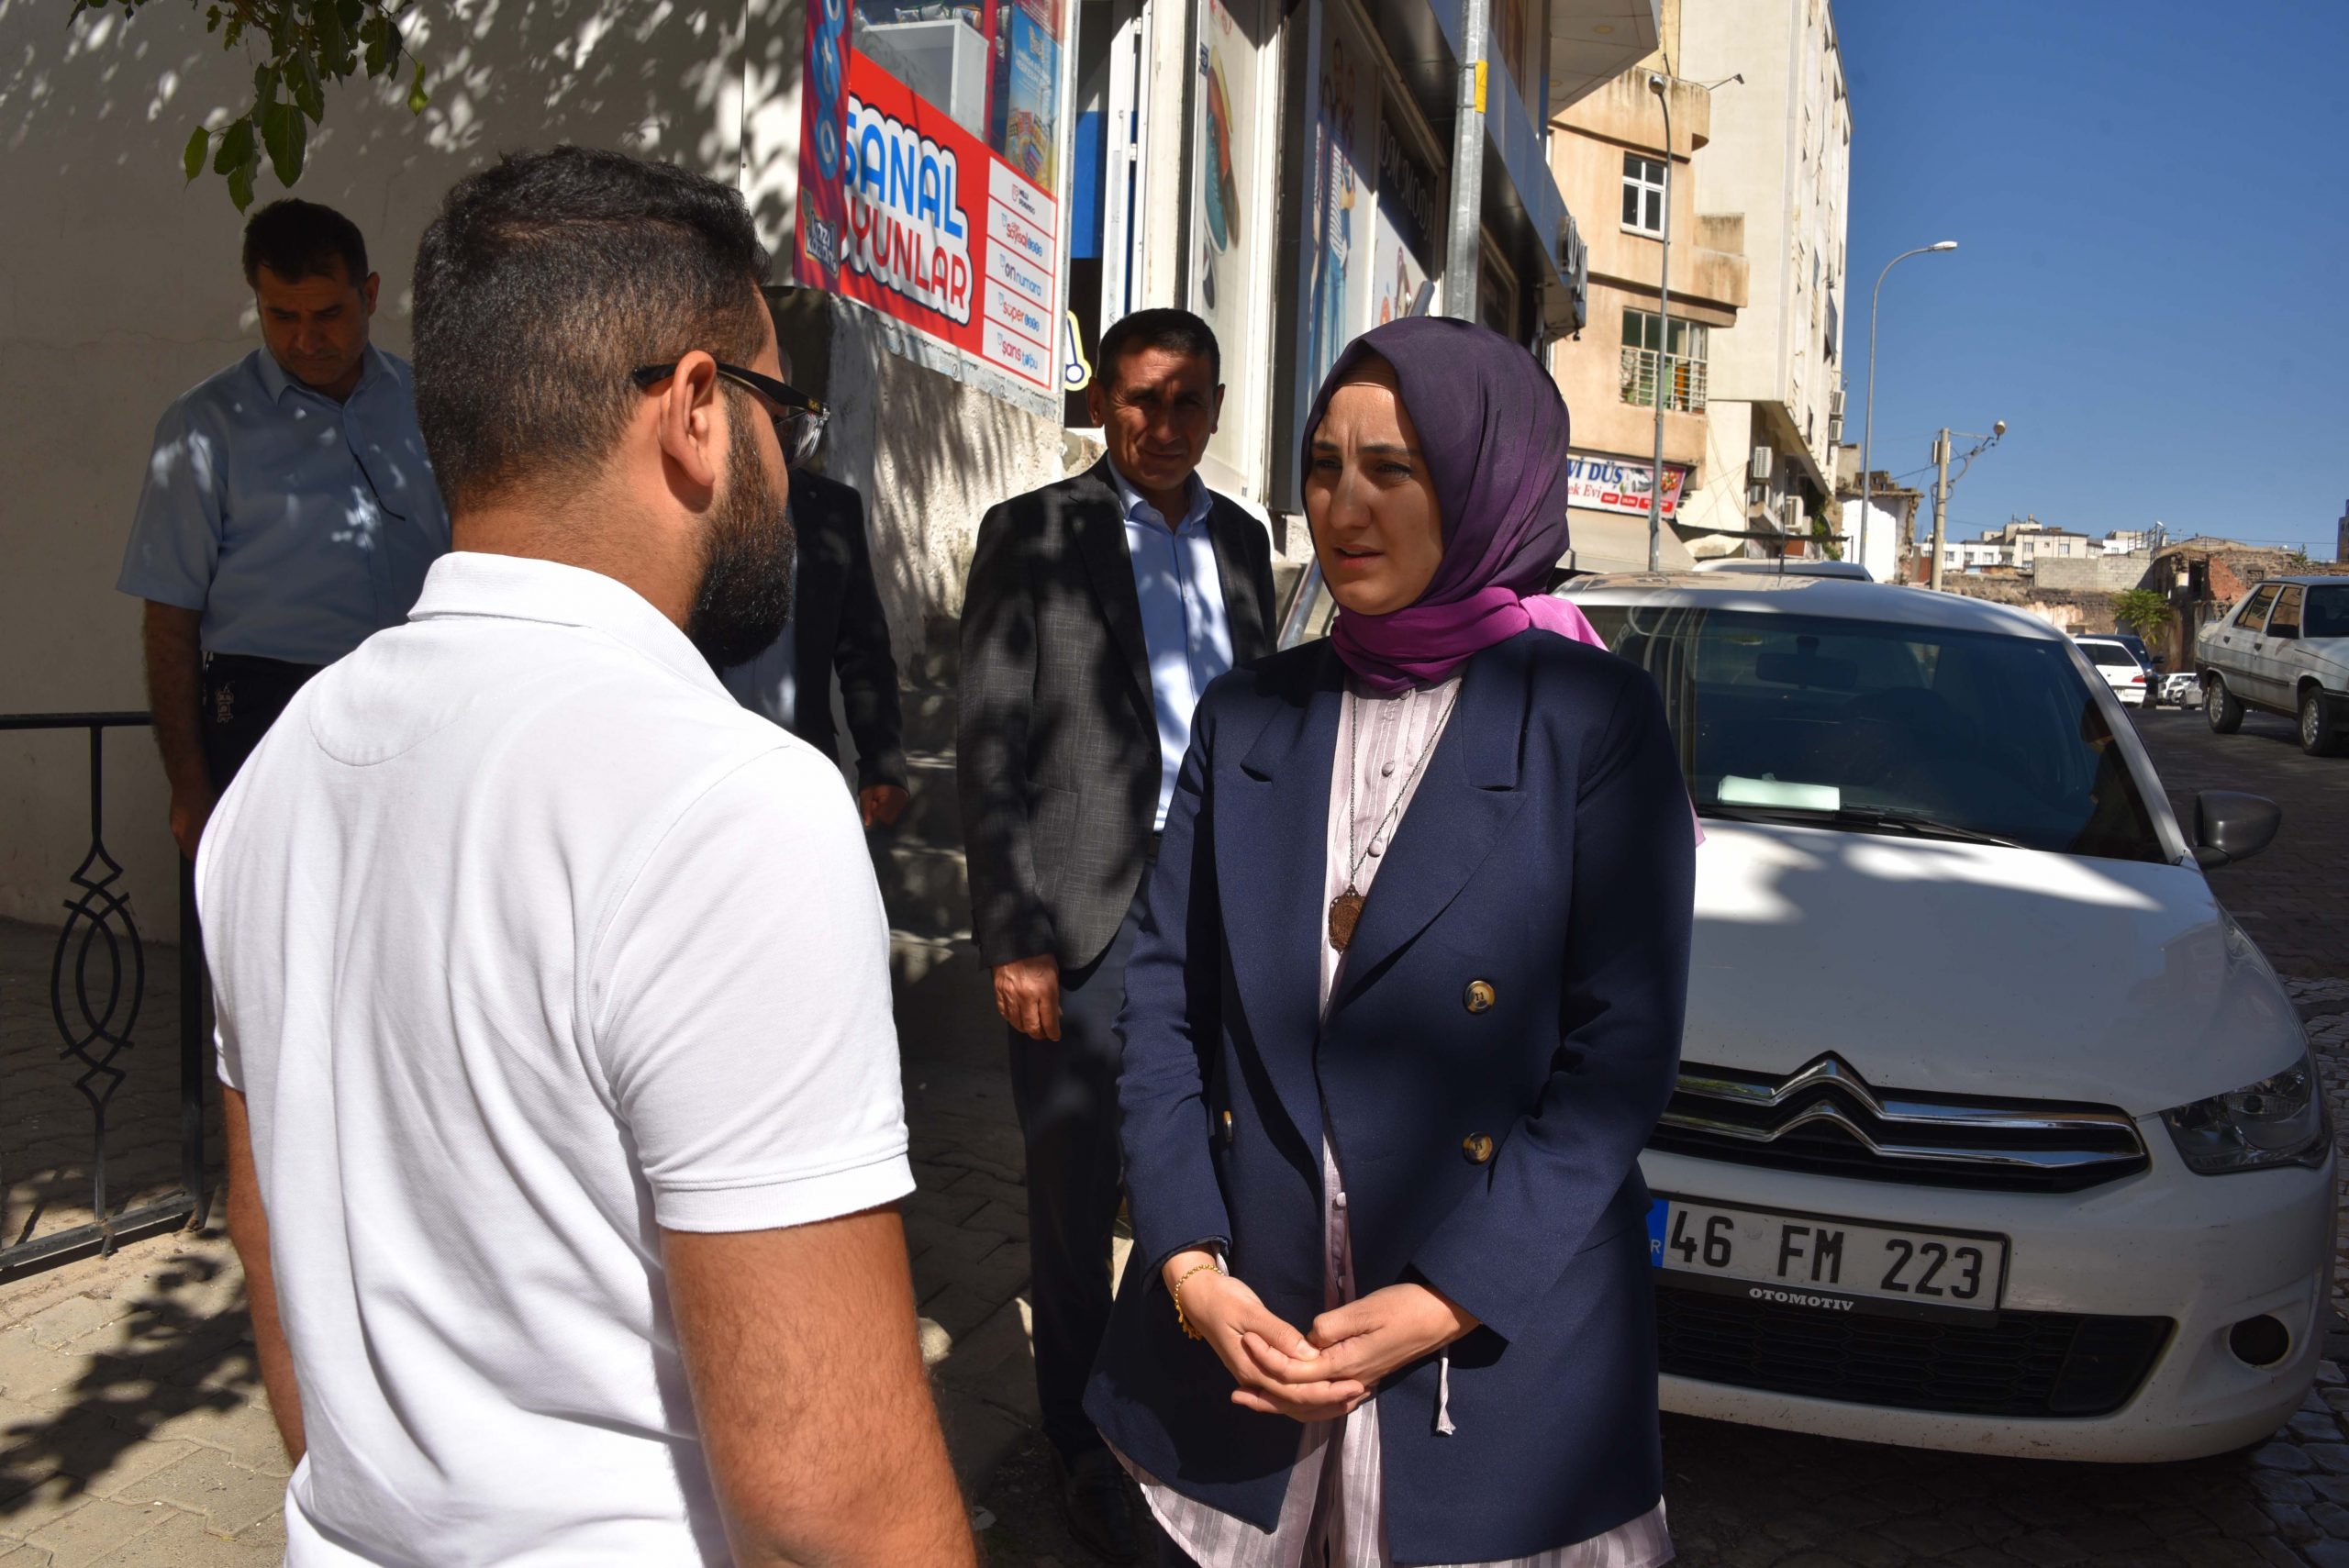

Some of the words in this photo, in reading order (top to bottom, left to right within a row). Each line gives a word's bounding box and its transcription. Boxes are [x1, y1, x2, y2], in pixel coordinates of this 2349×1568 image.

[843, 195, 967, 310] YUNLAR
[1588, 461, 1623, 489] DÜŞ
[1583, 484, 1601, 499] Evi
[1670, 1210, 1734, 1268] 46
[1776, 1224, 1844, 1284] FM
[1880, 1239, 1983, 1299] 223
[1749, 1287, 1854, 1311] OTOMOTIV
